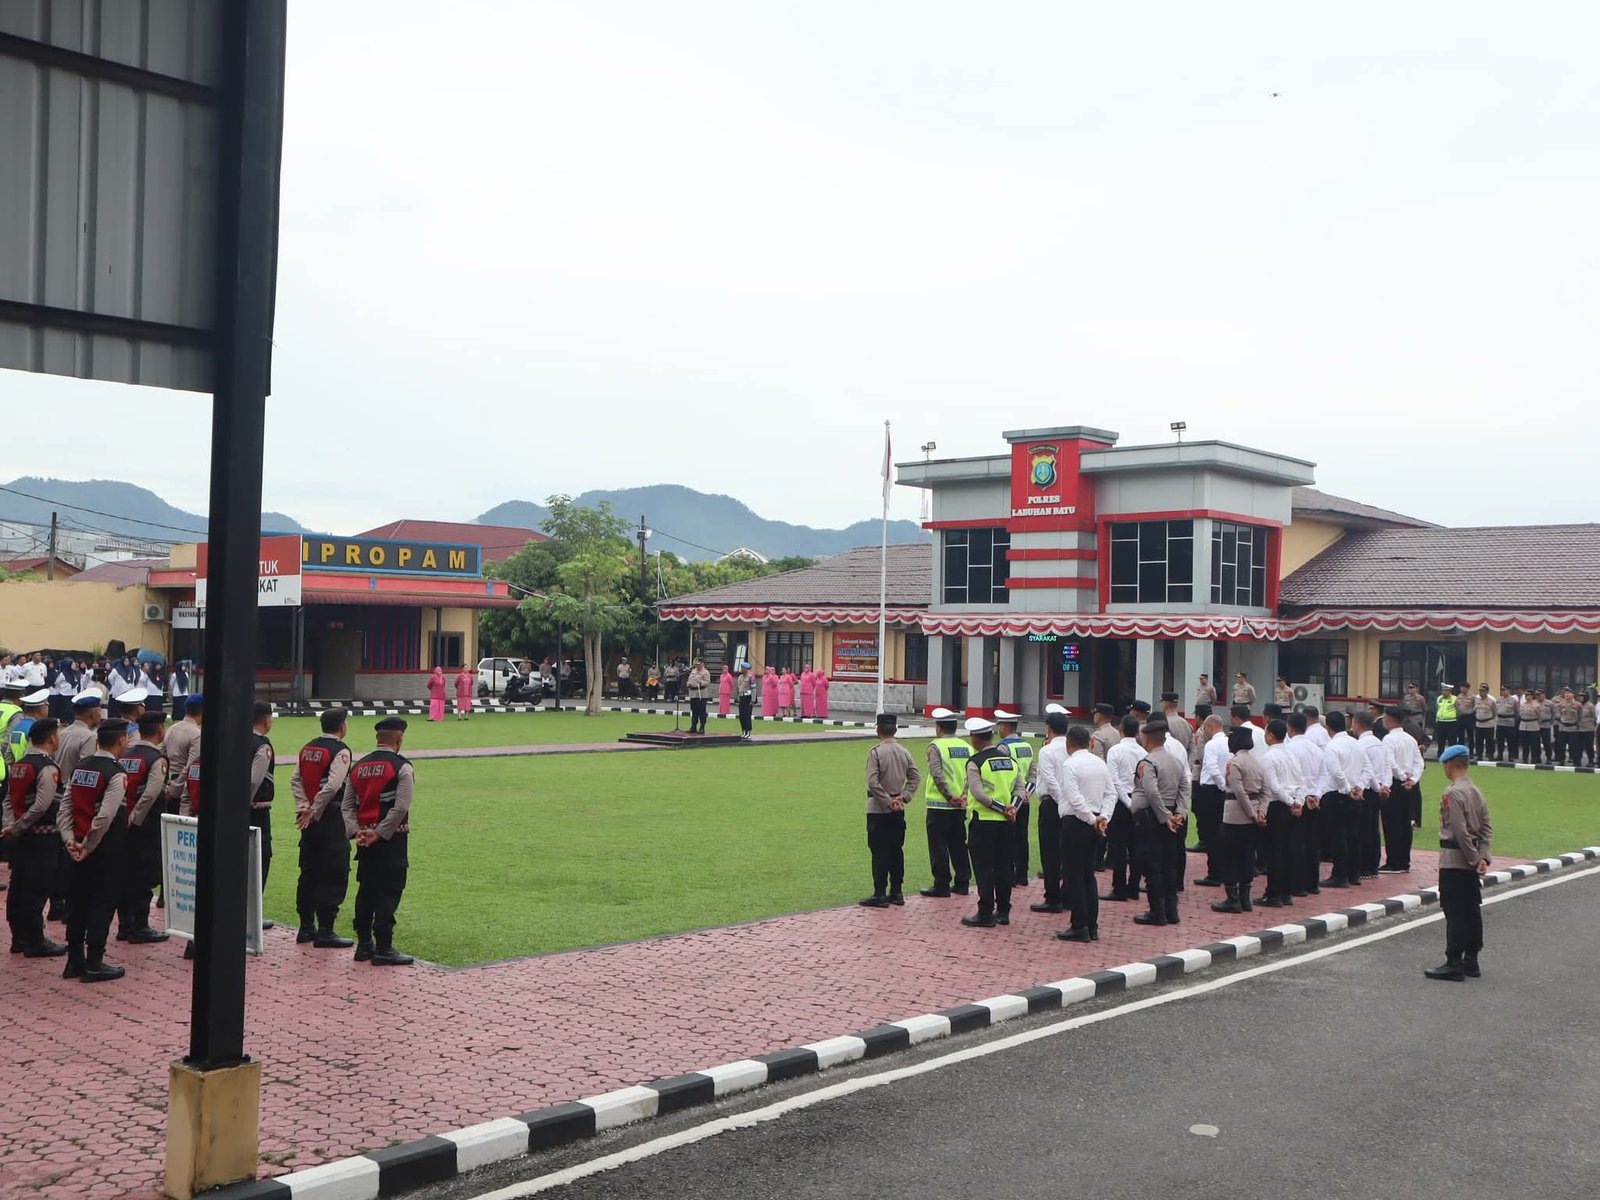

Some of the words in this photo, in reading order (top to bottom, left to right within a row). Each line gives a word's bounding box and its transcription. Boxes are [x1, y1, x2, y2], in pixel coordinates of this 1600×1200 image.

[1028, 495, 1060, 504] POLRES
[1012, 508, 1051, 517] LABUHAN
[1053, 506, 1075, 515] BATU
[259, 560, 278, 574] TUK
[259, 579, 278, 592] KAT
[1028, 634, 1057, 642] SYARAKAT
[301, 749, 323, 762] POLISI
[357, 764, 385, 778] POLISI
[991, 760, 1013, 770] POLISI
[74, 771, 99, 787] POLISI
